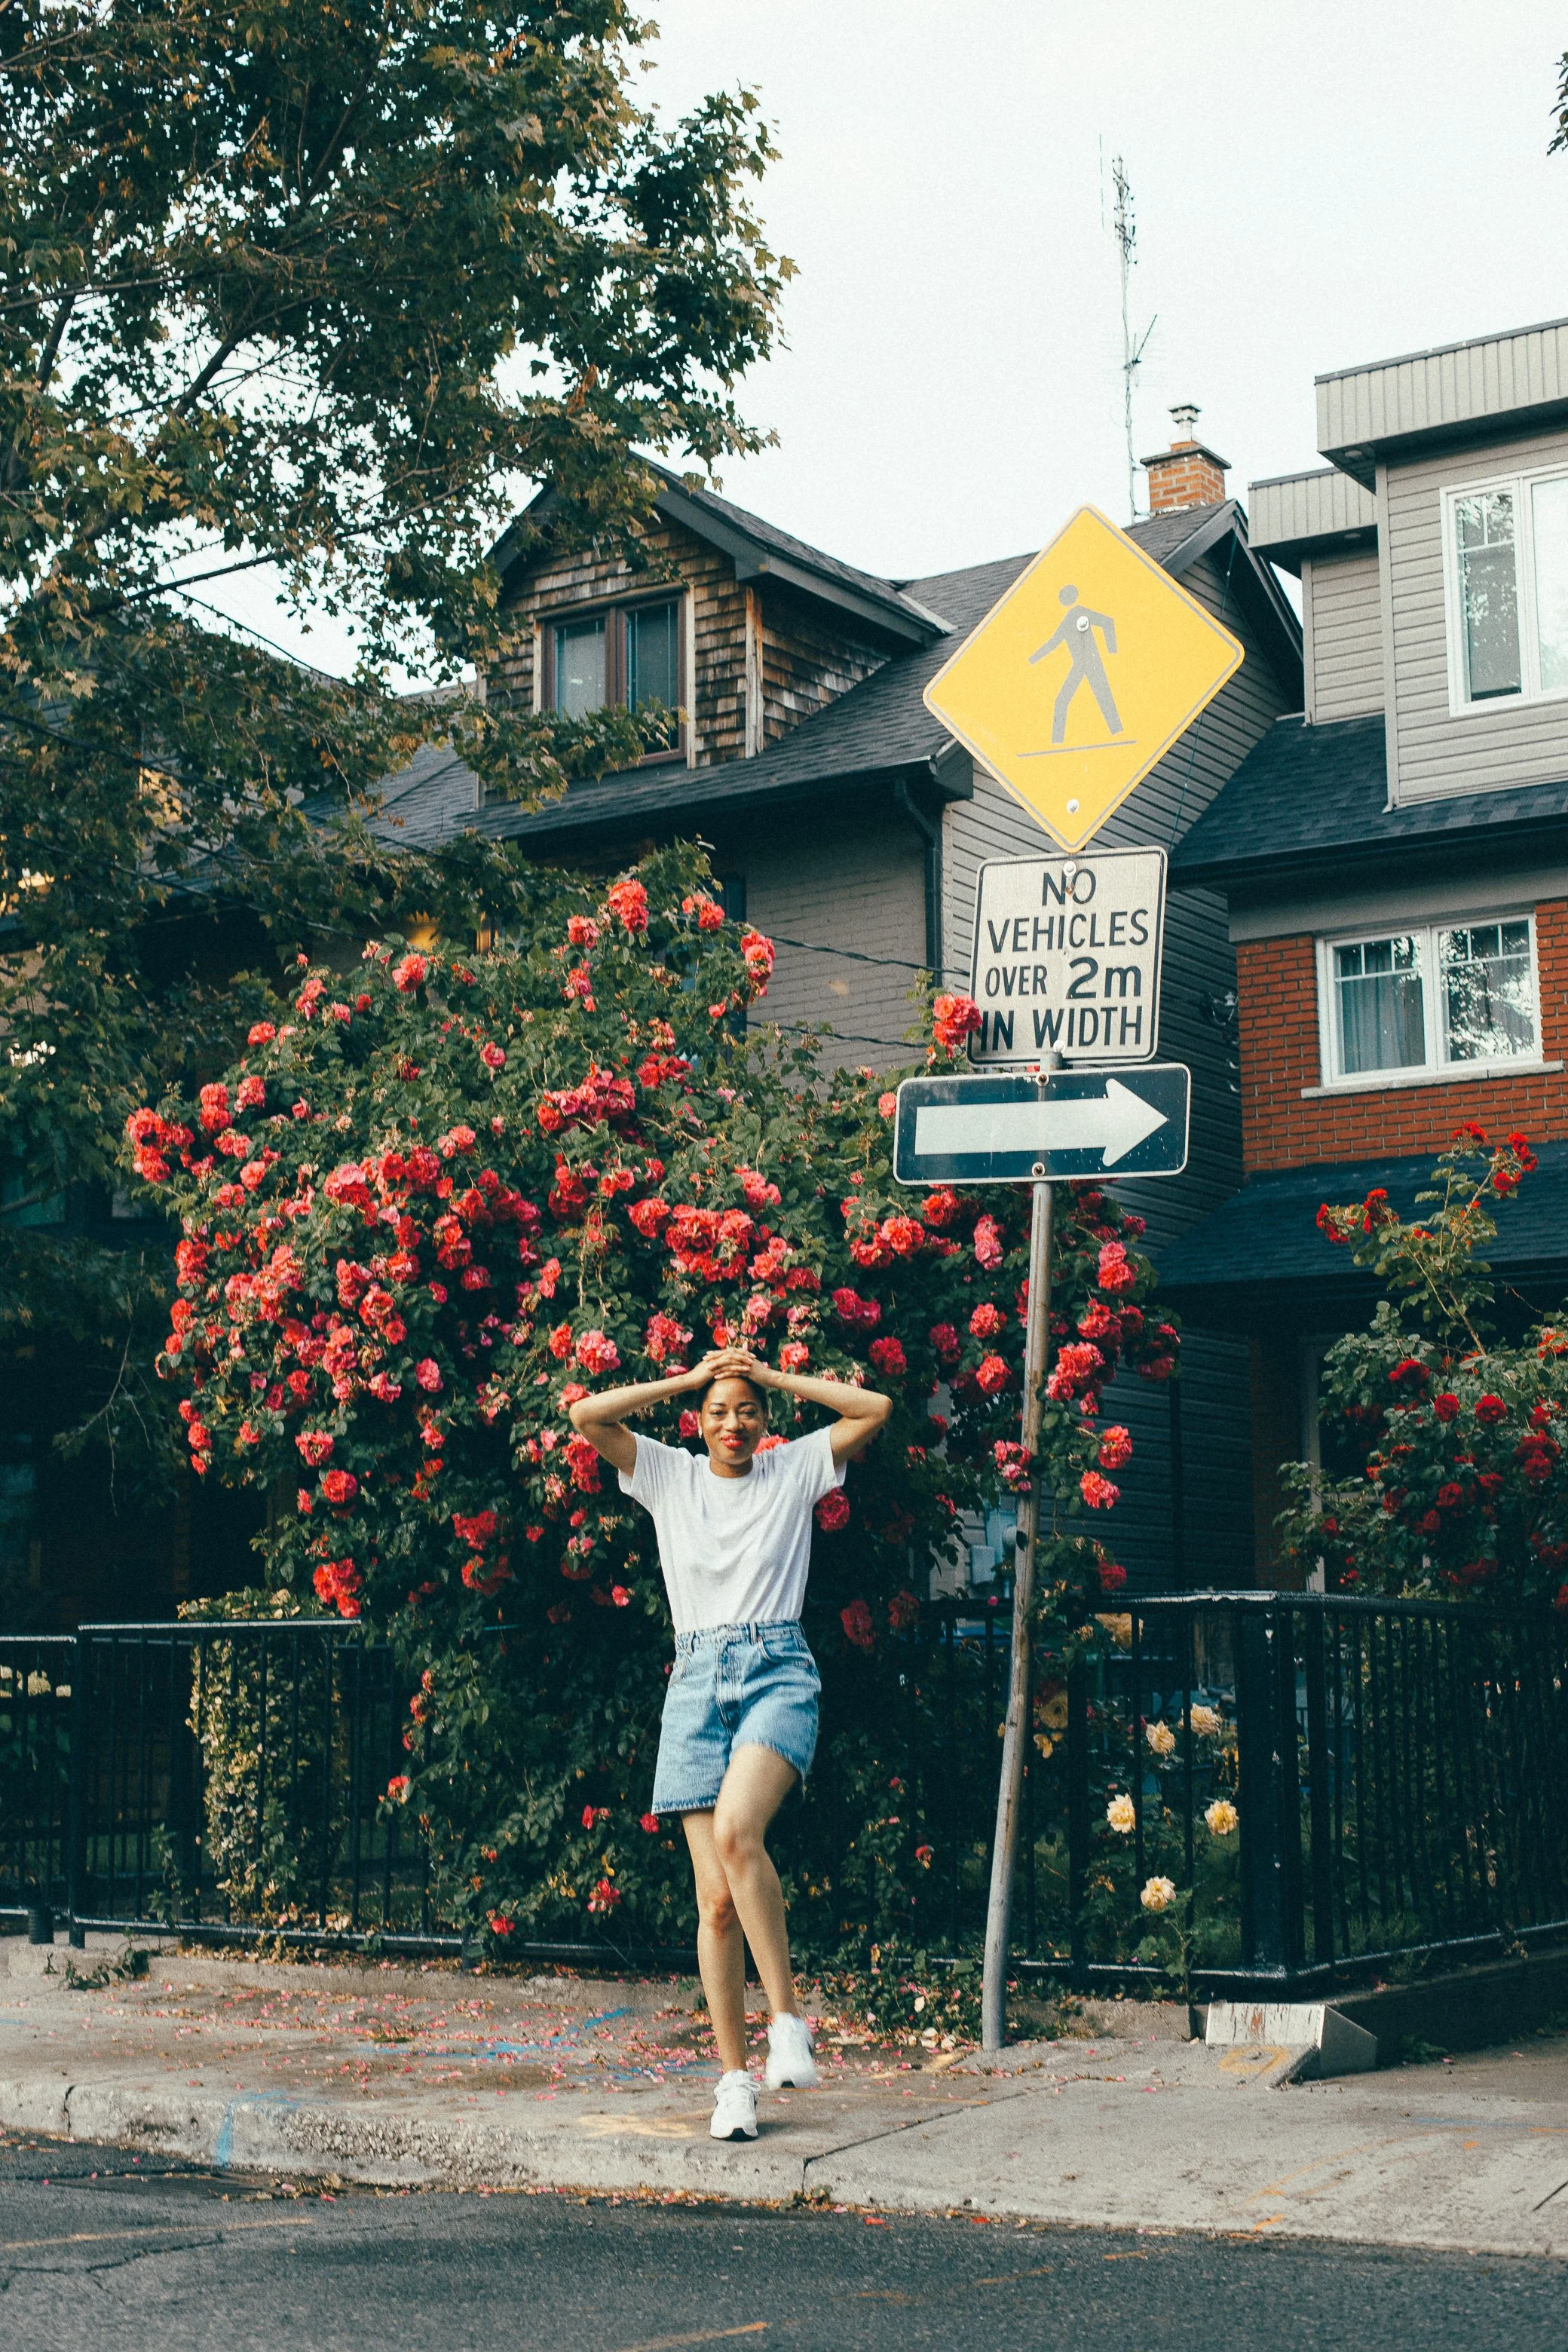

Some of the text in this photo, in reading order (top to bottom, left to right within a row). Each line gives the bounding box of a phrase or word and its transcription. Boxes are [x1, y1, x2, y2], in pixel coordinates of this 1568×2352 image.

[1042, 868, 1097, 906] NO
[987, 909, 1149, 954] VEHICLES
[985, 957, 1141, 1000] OVER 2m
[980, 1006, 1142, 1052] IN WIDTH
